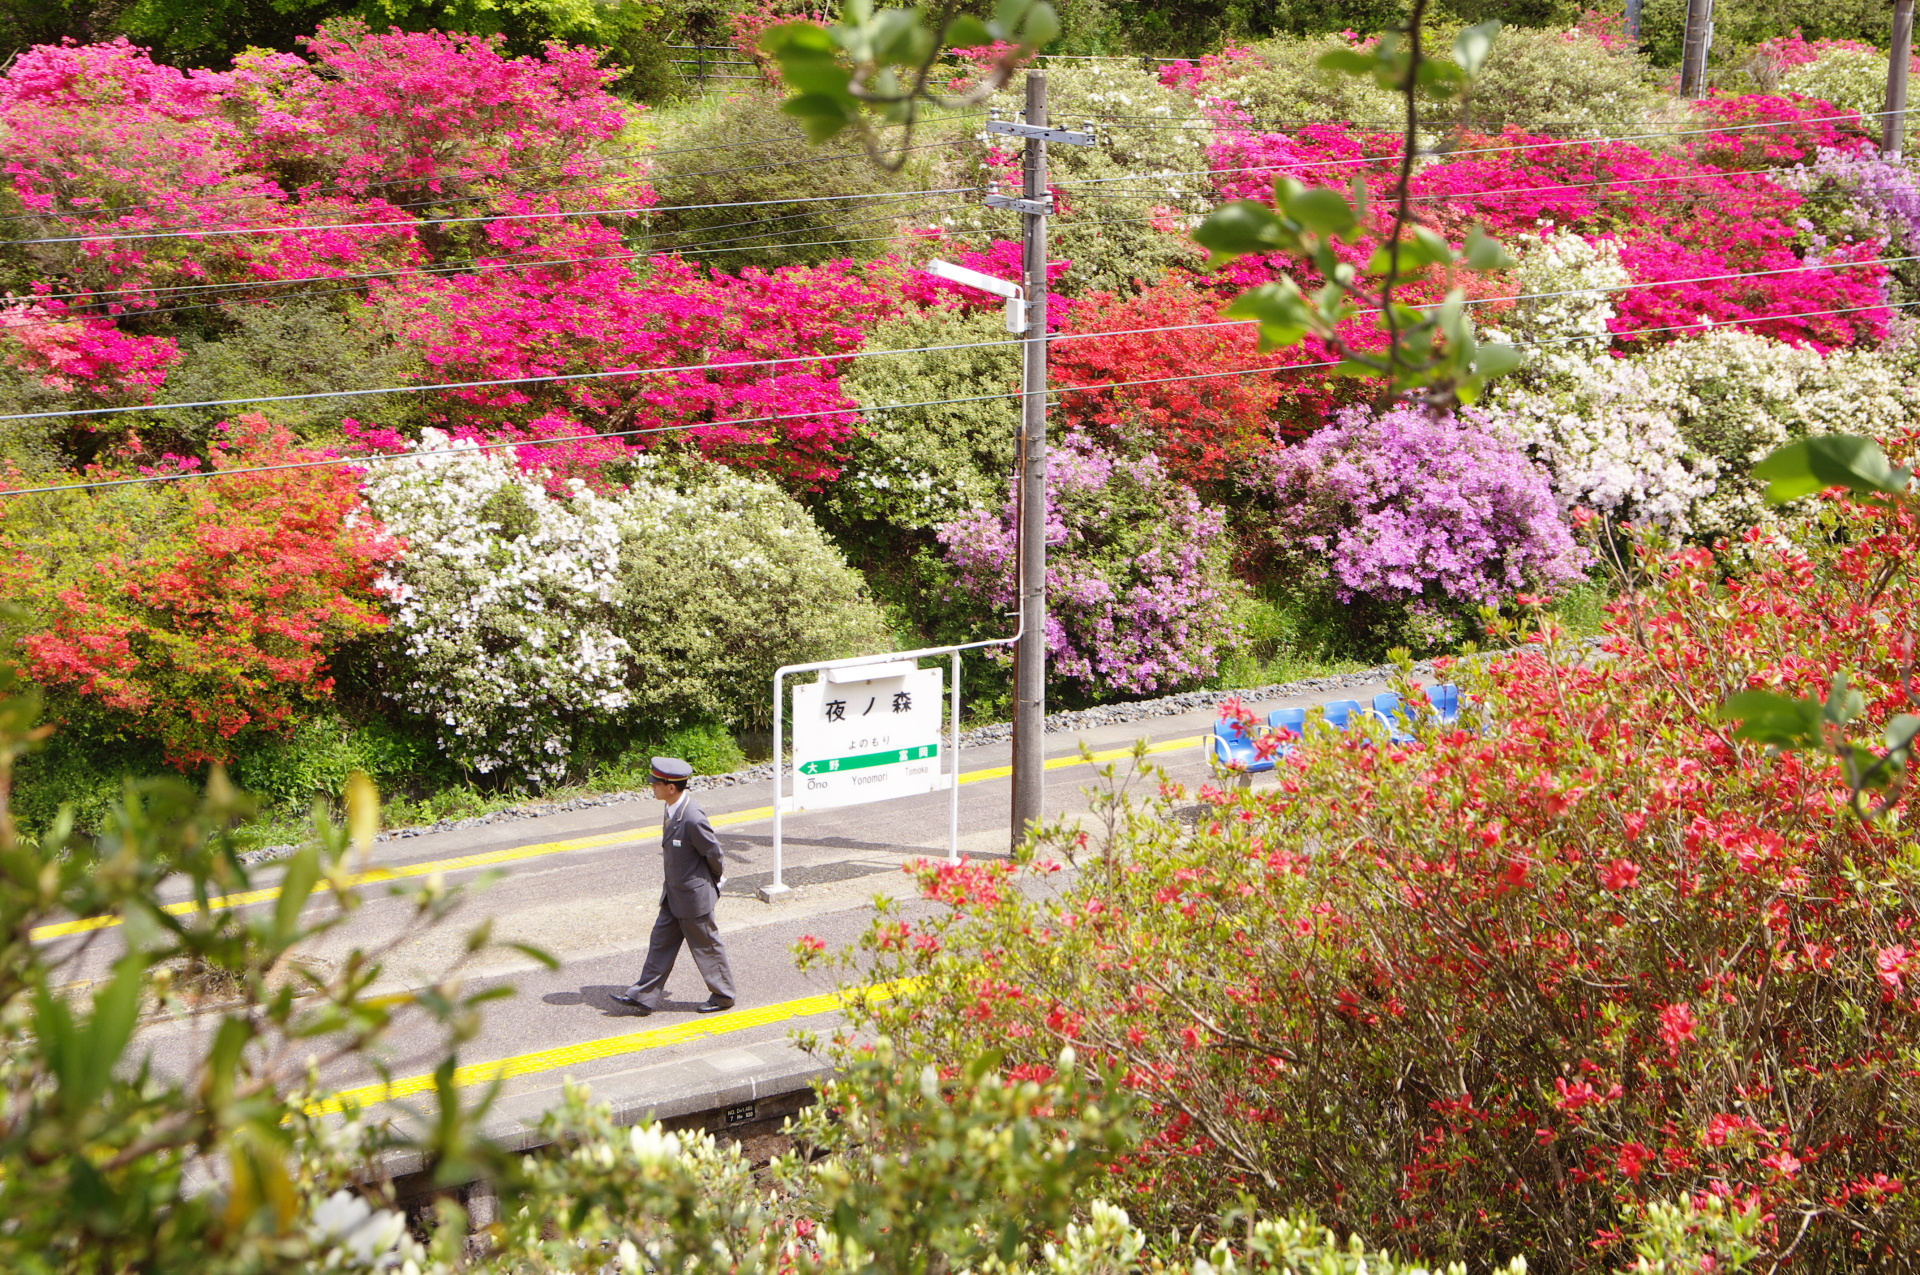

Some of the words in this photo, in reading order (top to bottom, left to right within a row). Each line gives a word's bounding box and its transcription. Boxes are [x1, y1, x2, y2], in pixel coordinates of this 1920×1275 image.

[825, 691, 912, 723] 夜ノ森
[848, 735, 890, 750] よのもり
[851, 771, 888, 786] Yonomori
[905, 766, 929, 776] Tomioka
